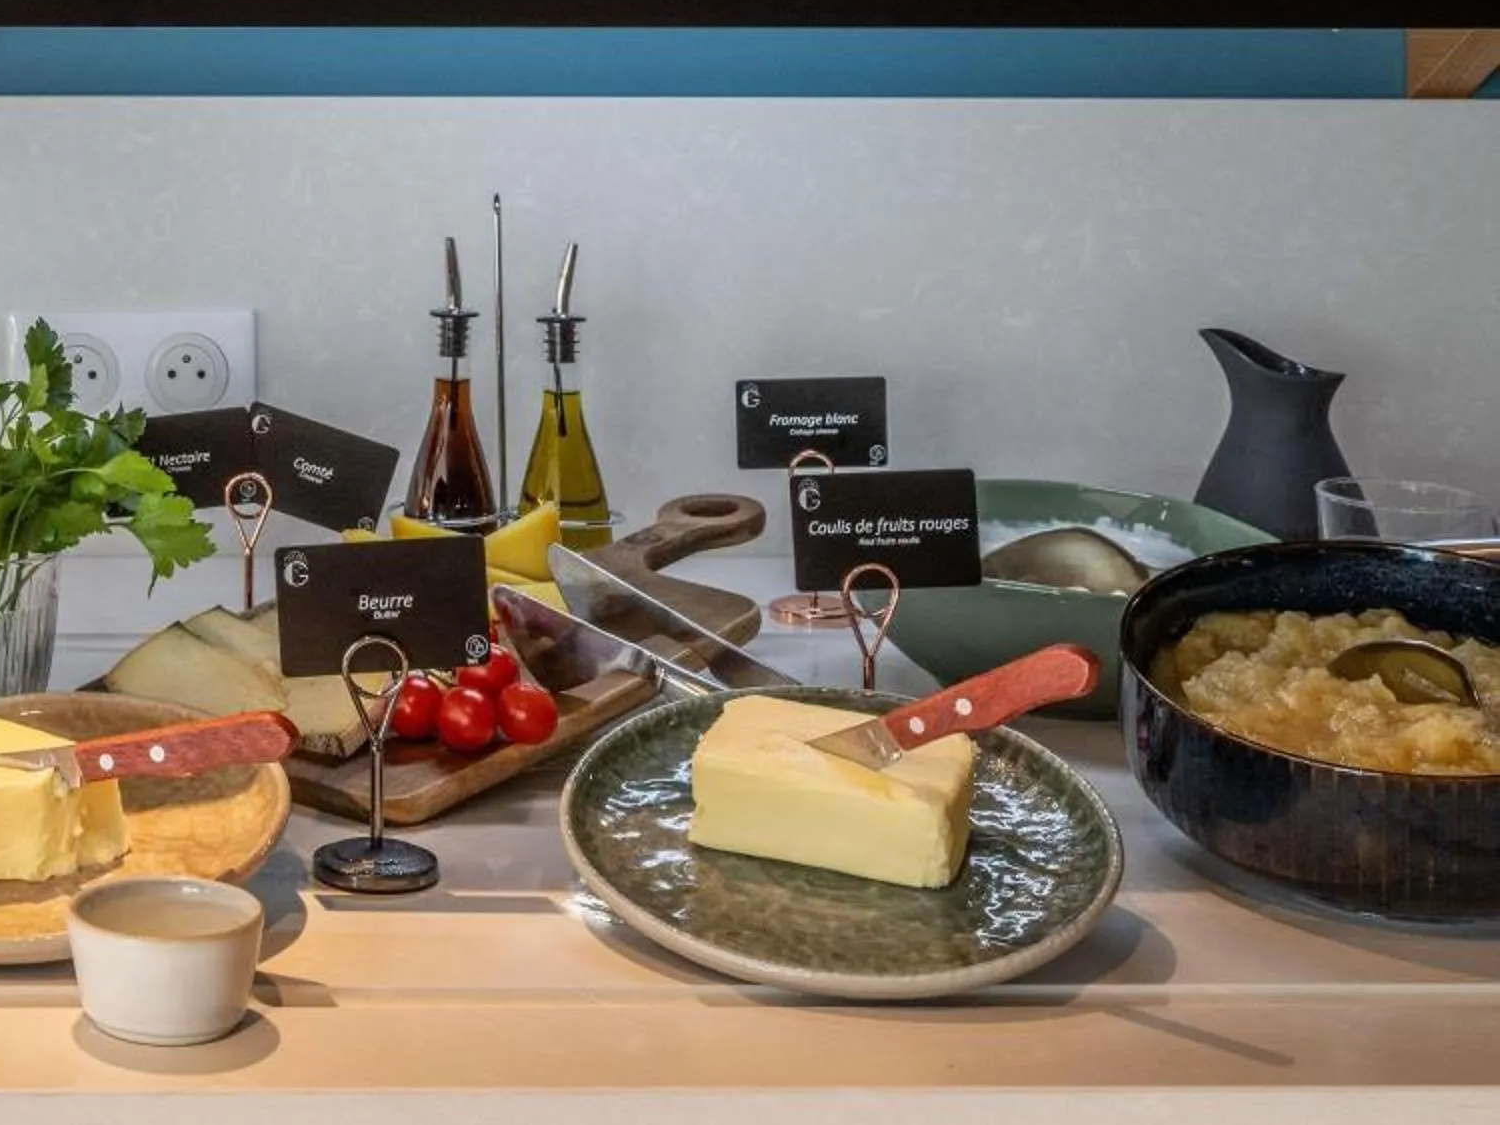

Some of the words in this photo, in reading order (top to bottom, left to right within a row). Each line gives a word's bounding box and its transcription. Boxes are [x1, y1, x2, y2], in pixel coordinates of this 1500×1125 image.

[769, 414, 823, 427] Fromage
[825, 413, 859, 425] blanc
[159, 450, 211, 467] Nectaire
[293, 456, 334, 480] Comté
[808, 519, 851, 536] Coulis
[855, 518, 873, 534] de
[875, 516, 915, 535] fruits
[919, 517, 969, 534] rouges
[358, 593, 414, 611] Beurre
